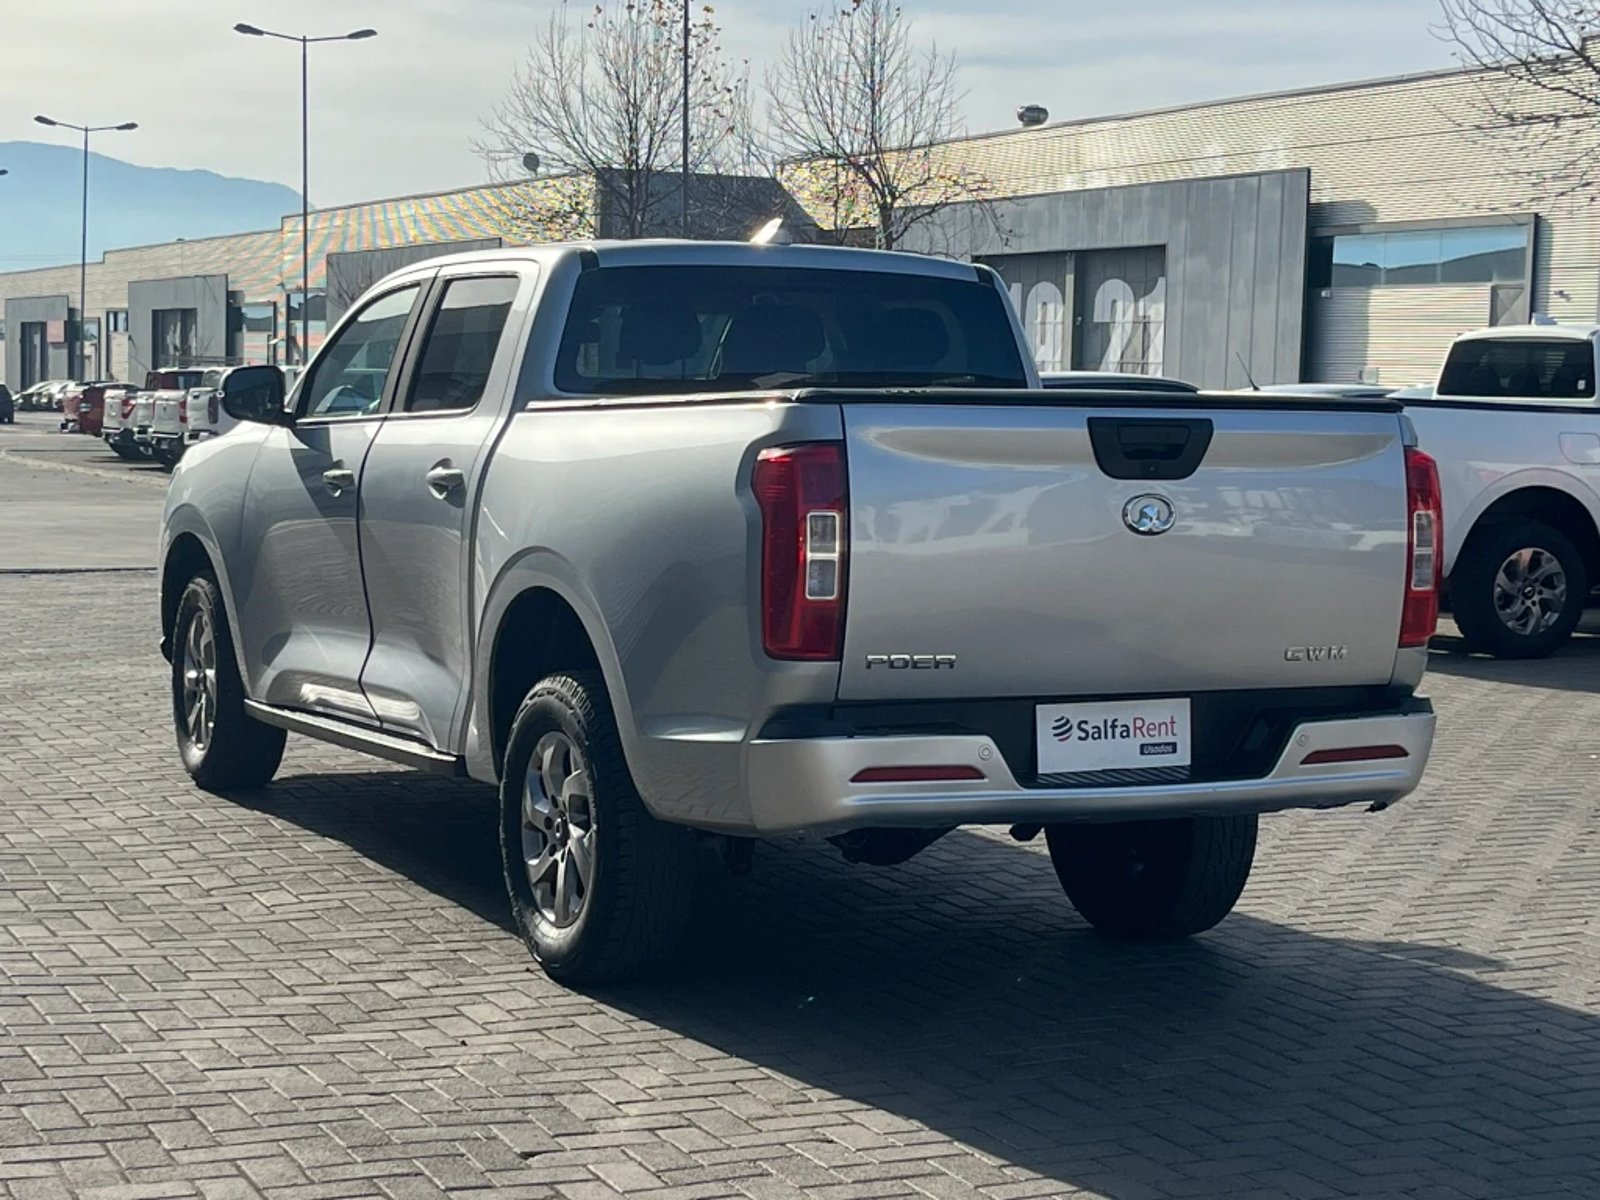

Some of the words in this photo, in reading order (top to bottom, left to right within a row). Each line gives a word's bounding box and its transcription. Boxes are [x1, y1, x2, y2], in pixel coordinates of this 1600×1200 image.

[865, 654, 957, 670] POER
[1284, 645, 1348, 662] GWM
[1077, 715, 1177, 741] SalfaRent
